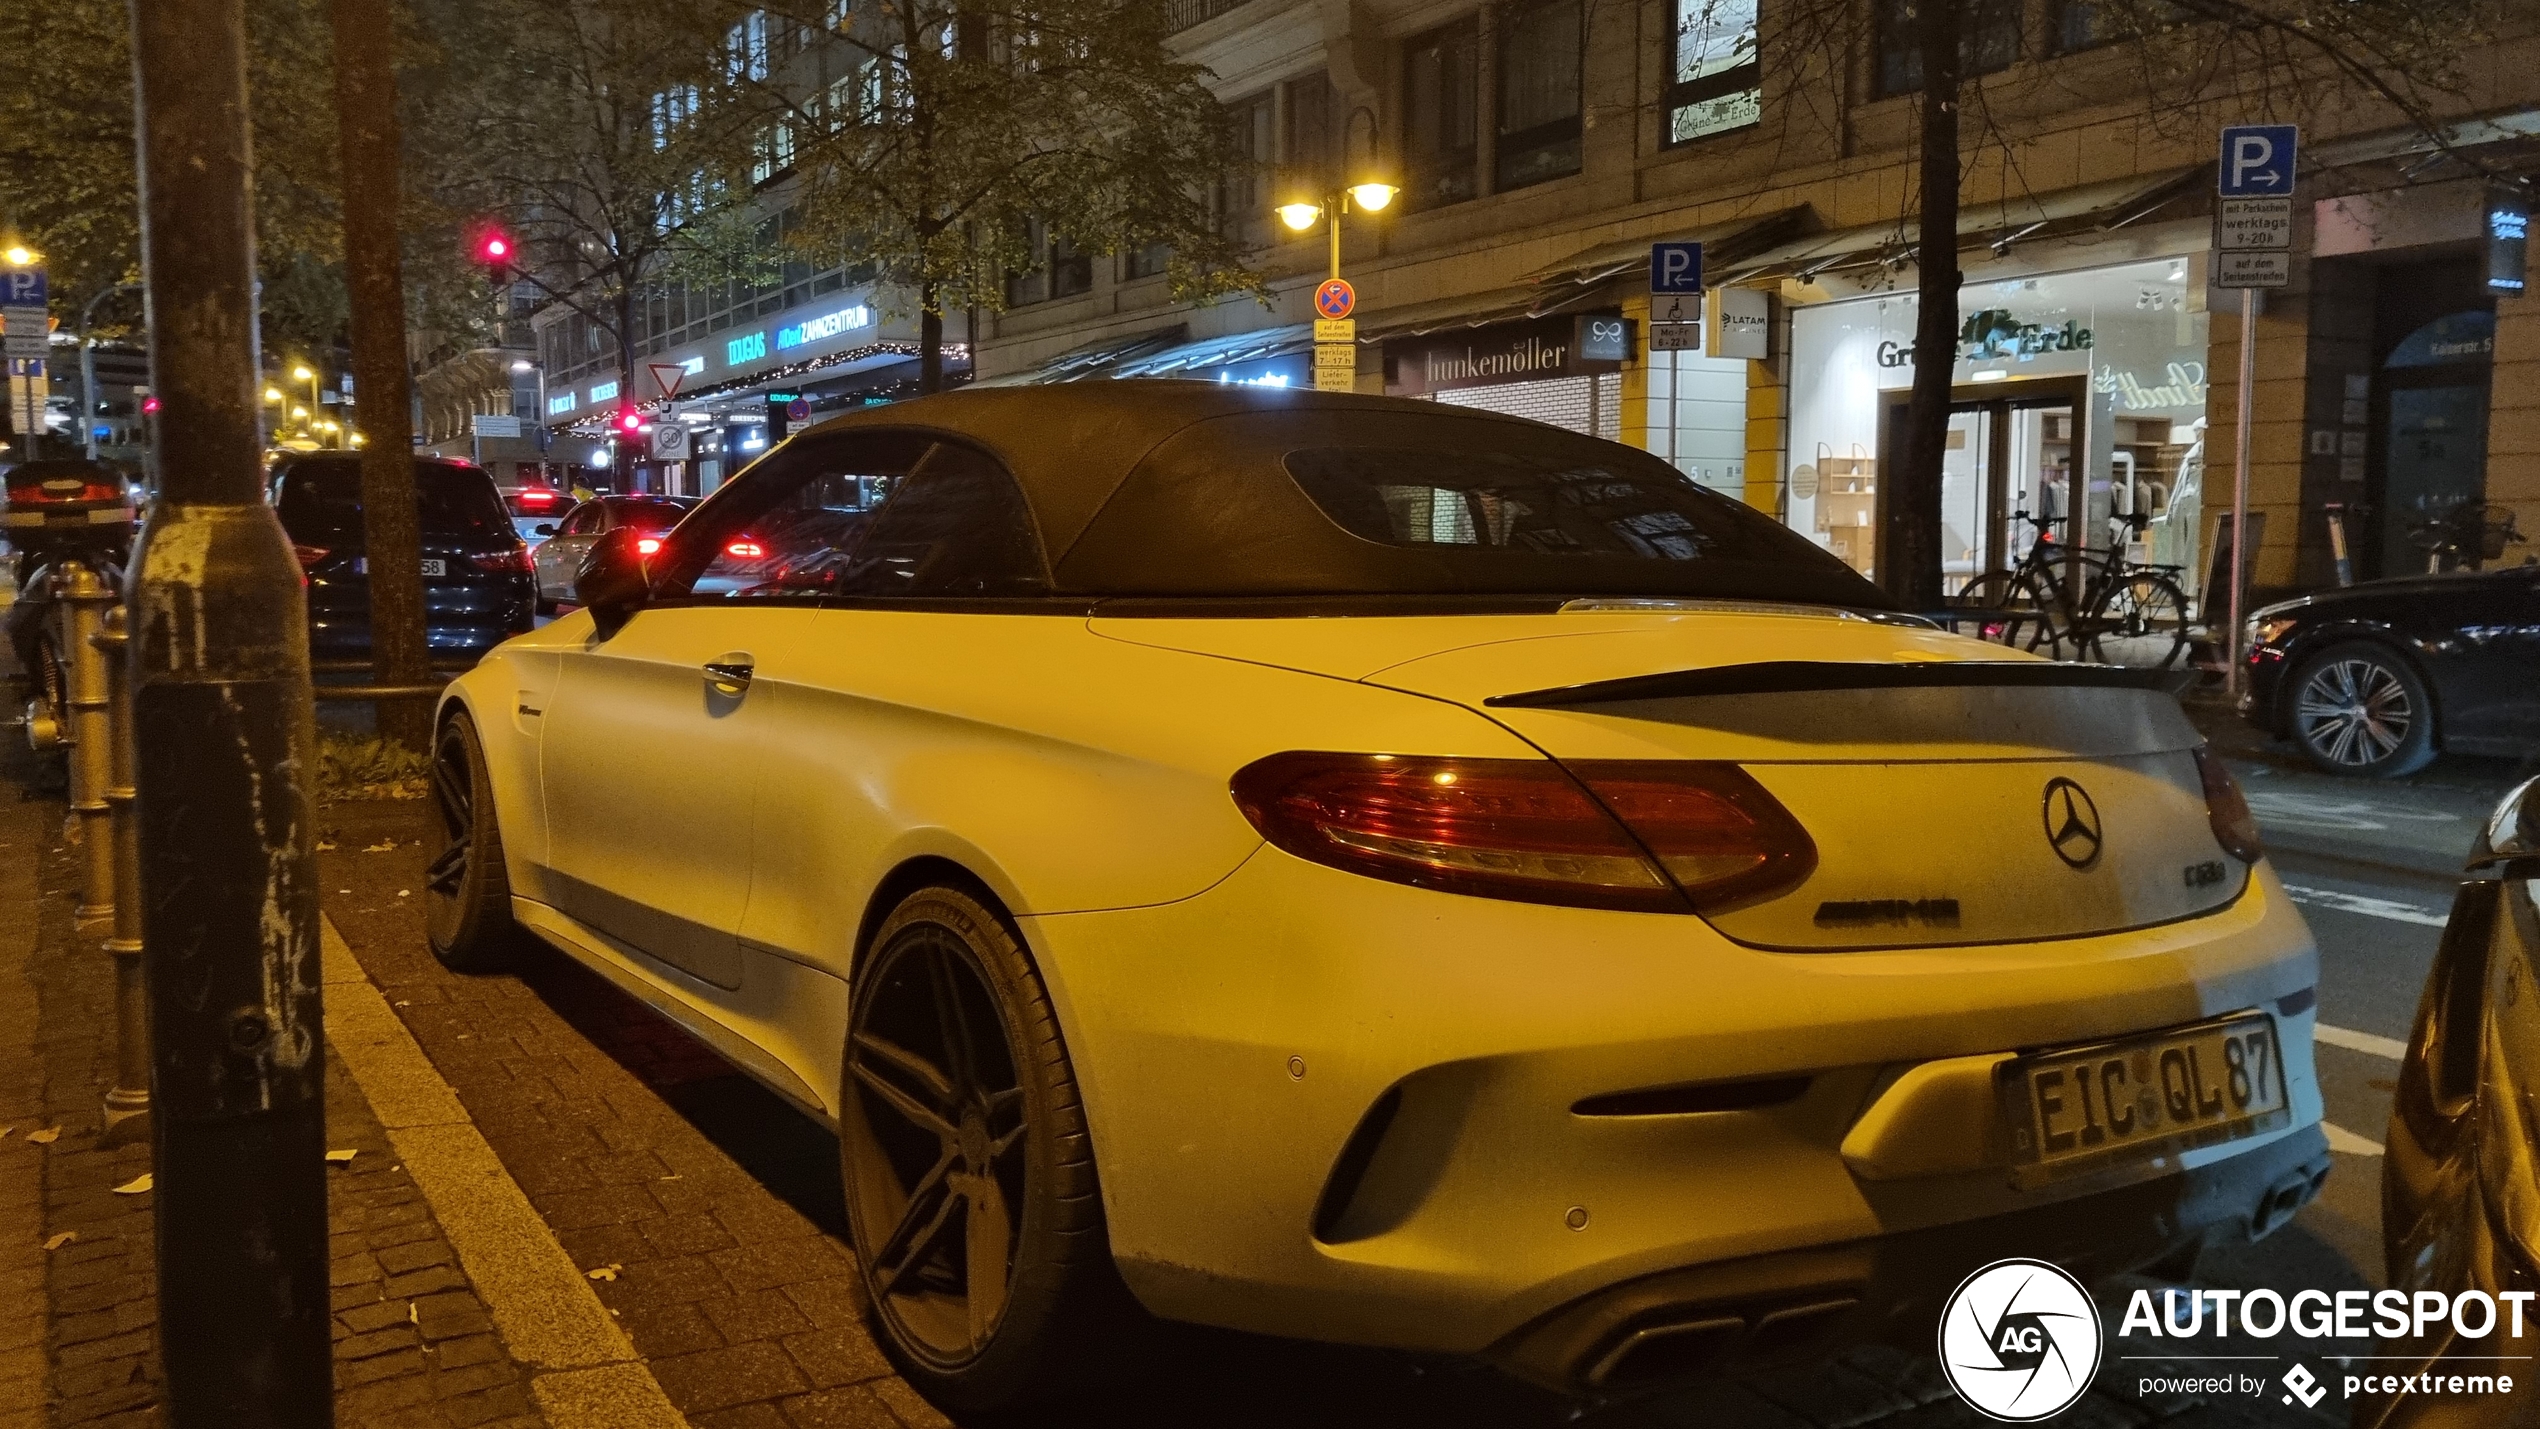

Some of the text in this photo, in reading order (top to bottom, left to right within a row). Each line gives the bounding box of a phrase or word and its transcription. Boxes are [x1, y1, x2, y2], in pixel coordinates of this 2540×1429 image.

[1731, 104, 1757, 120] Erde
[2233, 136, 2272, 187] P
[2225, 204, 2240, 213] mit
[2226, 217, 2288, 230] werktags
[1663, 249, 1690, 287] P
[2235, 259, 2274, 269] auf dem
[1732, 316, 1766, 325] LATAM
[728, 331, 766, 366] DOUGLAS
[1319, 348, 1352, 357] werktags
[1427, 336, 1566, 382] hunkemöller
[662, 432, 679, 444] 30
[1690, 465, 1699, 480] 5
[2034, 1030, 2268, 1151] EIC QL 87
